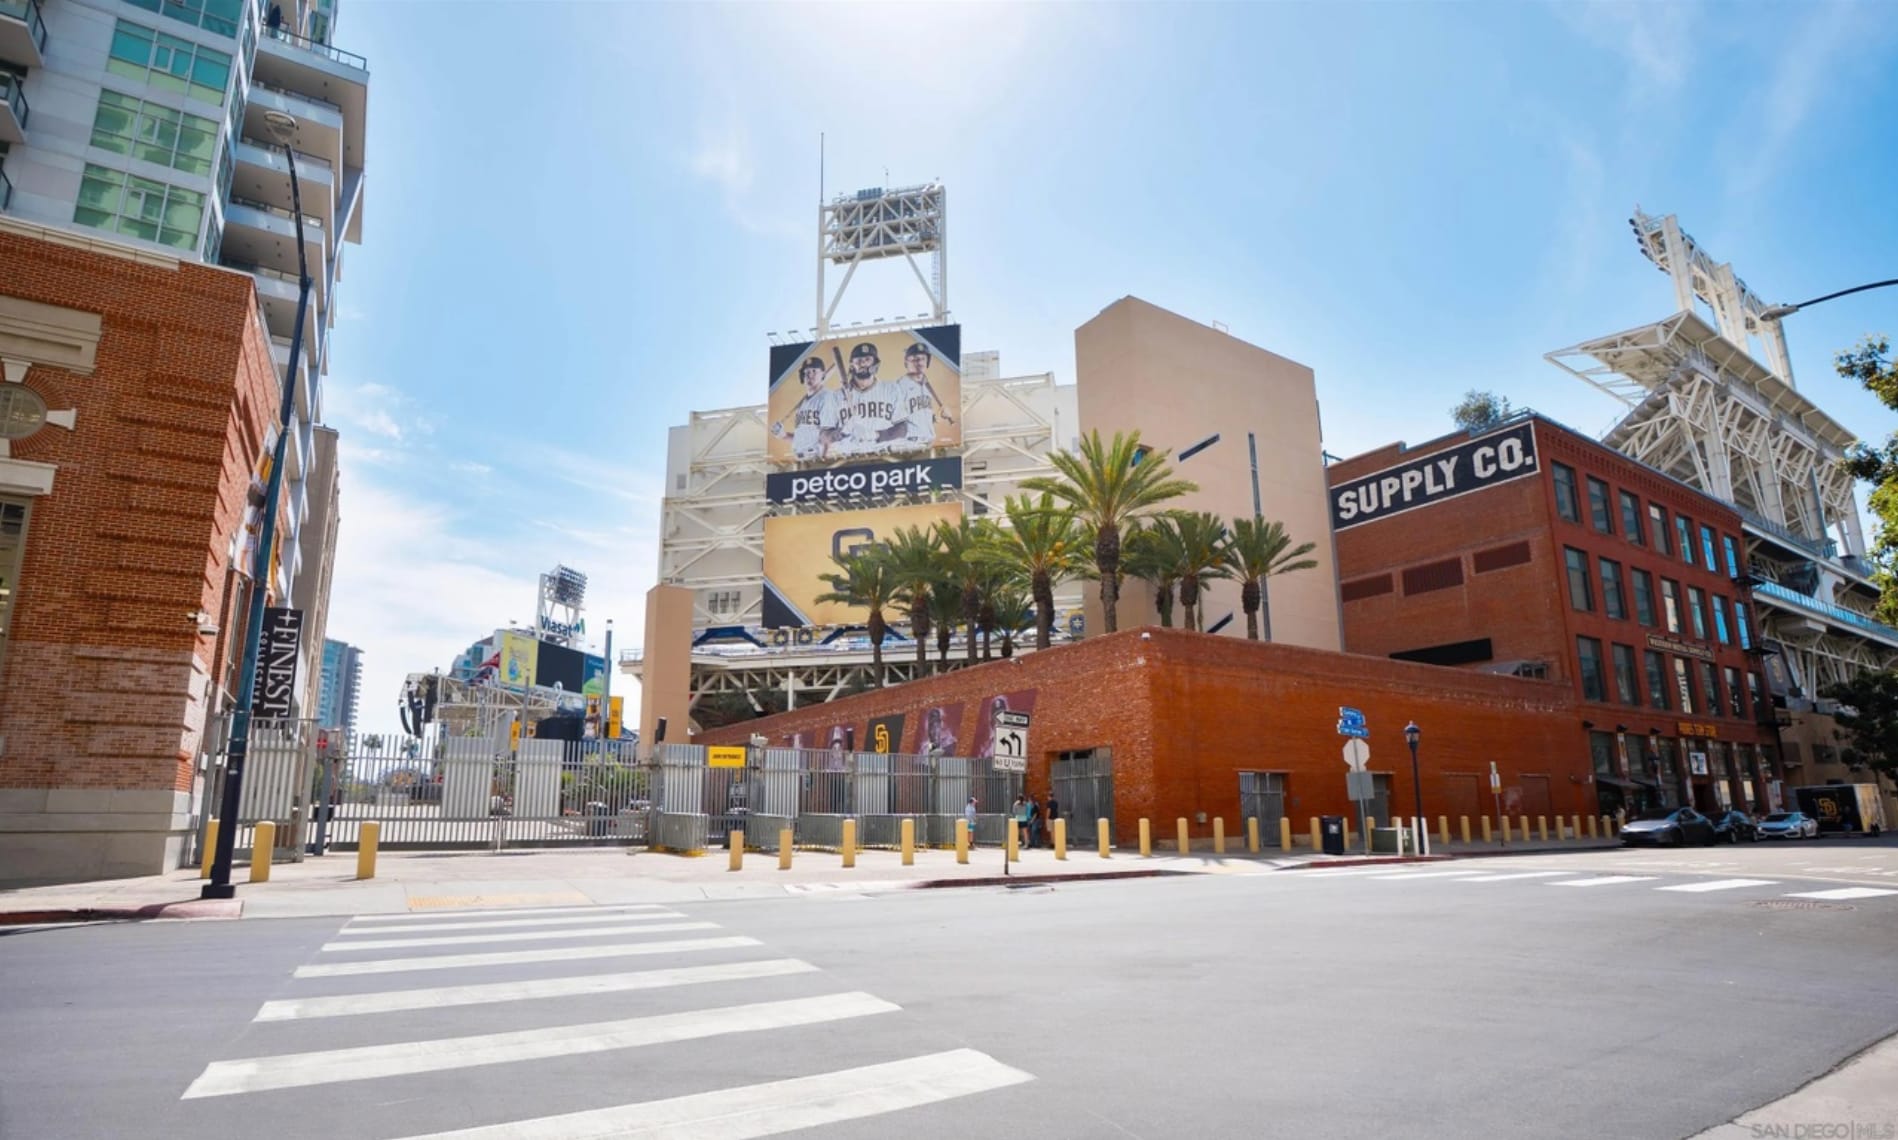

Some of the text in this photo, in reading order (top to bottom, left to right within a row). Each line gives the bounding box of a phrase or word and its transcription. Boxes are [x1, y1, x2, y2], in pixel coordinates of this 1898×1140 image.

[792, 464, 932, 500] petco park
[1338, 437, 1534, 520] SUPPLY CO.
[540, 614, 574, 638] Viasat
[263, 625, 299, 717] FINEST
